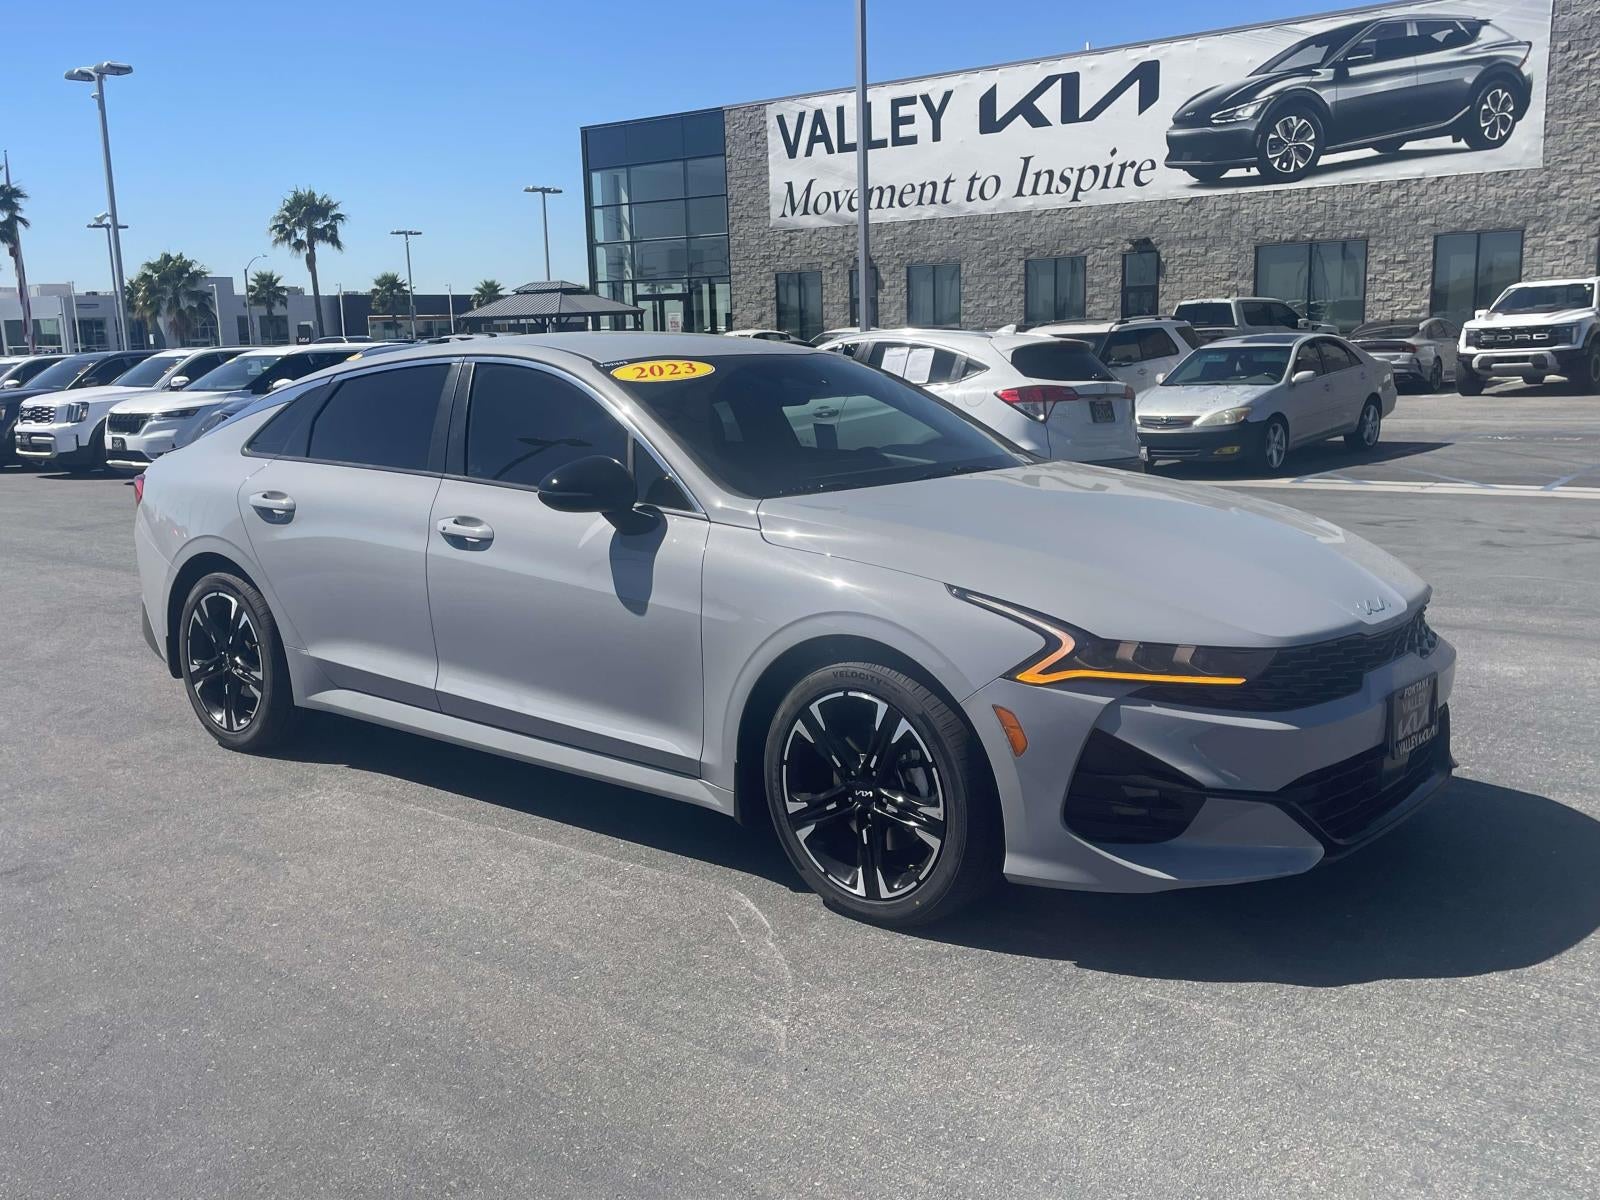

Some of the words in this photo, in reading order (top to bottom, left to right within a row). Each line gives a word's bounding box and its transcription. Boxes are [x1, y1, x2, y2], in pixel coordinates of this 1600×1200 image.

[776, 89, 954, 159] VALLEY
[979, 59, 1160, 135] KIA
[778, 171, 957, 218] Movement
[965, 170, 1001, 202] to
[1012, 146, 1157, 203] Inspire
[632, 361, 698, 380] 2023
[832, 670, 883, 685] VELOCITY
